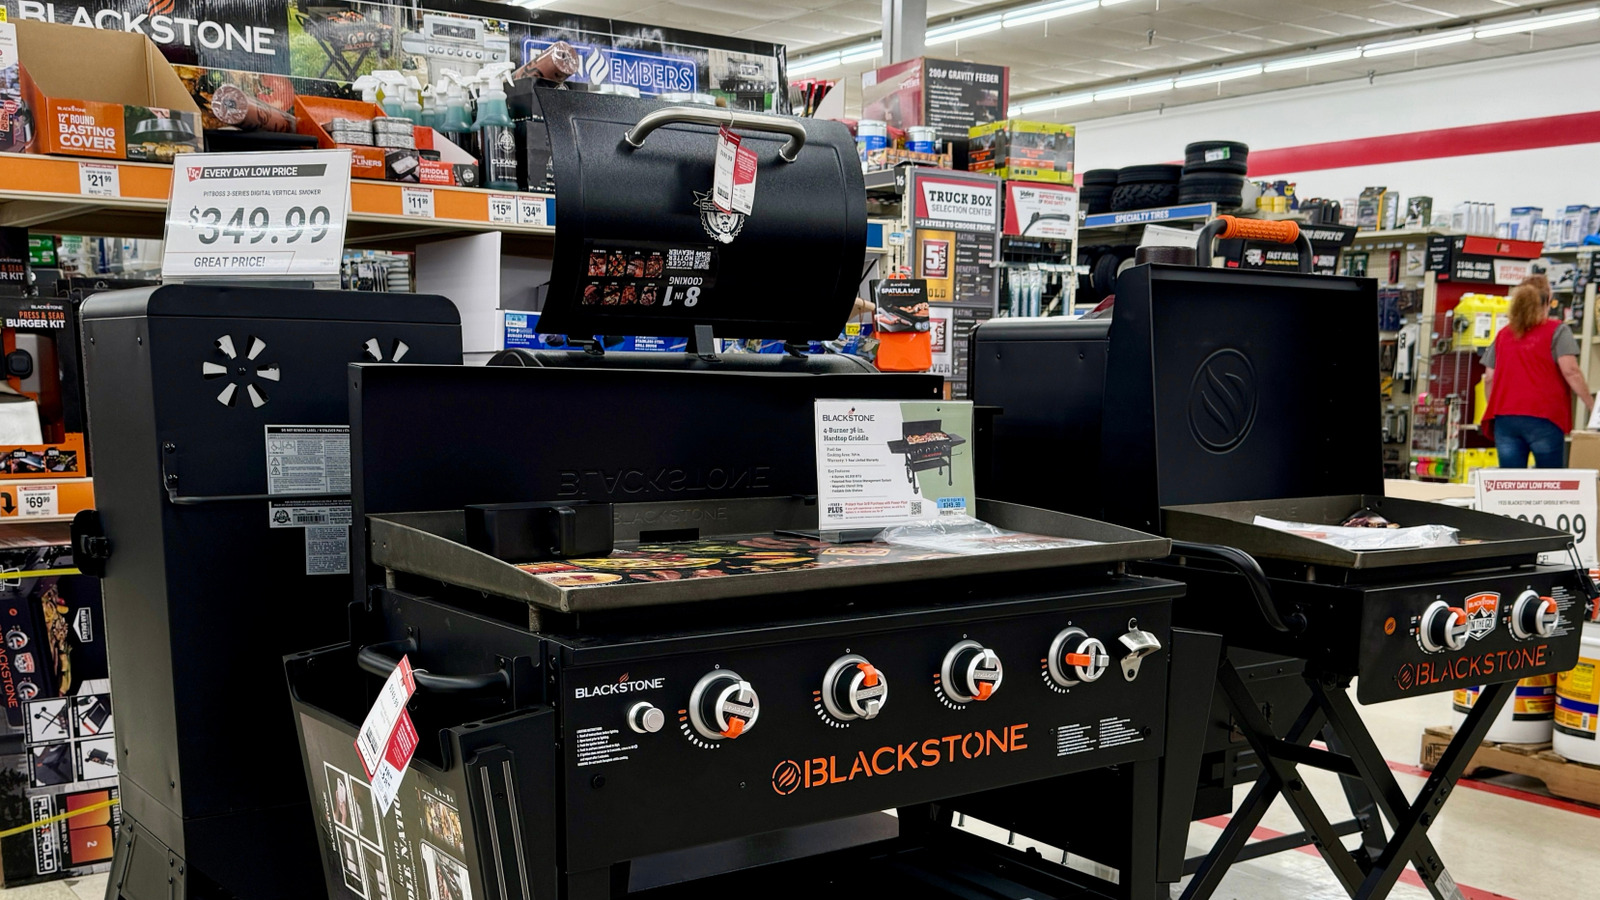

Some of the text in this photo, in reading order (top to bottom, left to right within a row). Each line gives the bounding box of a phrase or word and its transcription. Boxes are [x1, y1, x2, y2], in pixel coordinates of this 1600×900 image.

[18, 0, 275, 55] BLACKSTONE
[610, 58, 691, 90] EMBERS
[948, 70, 974, 81] GRAVITY
[975, 73, 999, 84] FEEDER
[70, 114, 95, 125] ROUND
[59, 123, 115, 137] BASTING
[60, 134, 116, 150] COVER
[357, 159, 382, 167] LINERS
[188, 167, 298, 179] TSC EVERY DAY LOW PRICE
[896, 175, 904, 187] 16
[929, 189, 992, 207] TRUCK BOX
[931, 203, 993, 217] SELECTION CENTER
[1115, 210, 1169, 224] SPECIALTY TIRES
[189, 205, 331, 244] $349.99
[954, 222, 976, 230] CHOOSE
[957, 233, 976, 241] RATING
[194, 256, 266, 267] GREAT PRICE!
[926, 245, 939, 270] 5
[939, 245, 947, 270] YEAR
[1266, 251, 1299, 261] FAST DELIV
[9, 272, 25, 280] KIT
[956, 265, 979, 274] BENEFITS
[668, 276, 703, 286] COOKING
[662, 286, 701, 307] 8 IN 1
[929, 288, 946, 298] OLD
[19, 310, 64, 320] PRESS & SEAR
[6, 319, 66, 329] BURGER KIT
[936, 322, 944, 345] YEAR
[822, 414, 875, 422] BLACKSTONE
[1416, 645, 1548, 686] BLACKSTONE
[575, 677, 664, 699] BLACKSTONE
[804, 723, 1028, 789] BLACKSTONE
[394, 793, 410, 860] NATIO
[86, 840, 98, 848] 2
